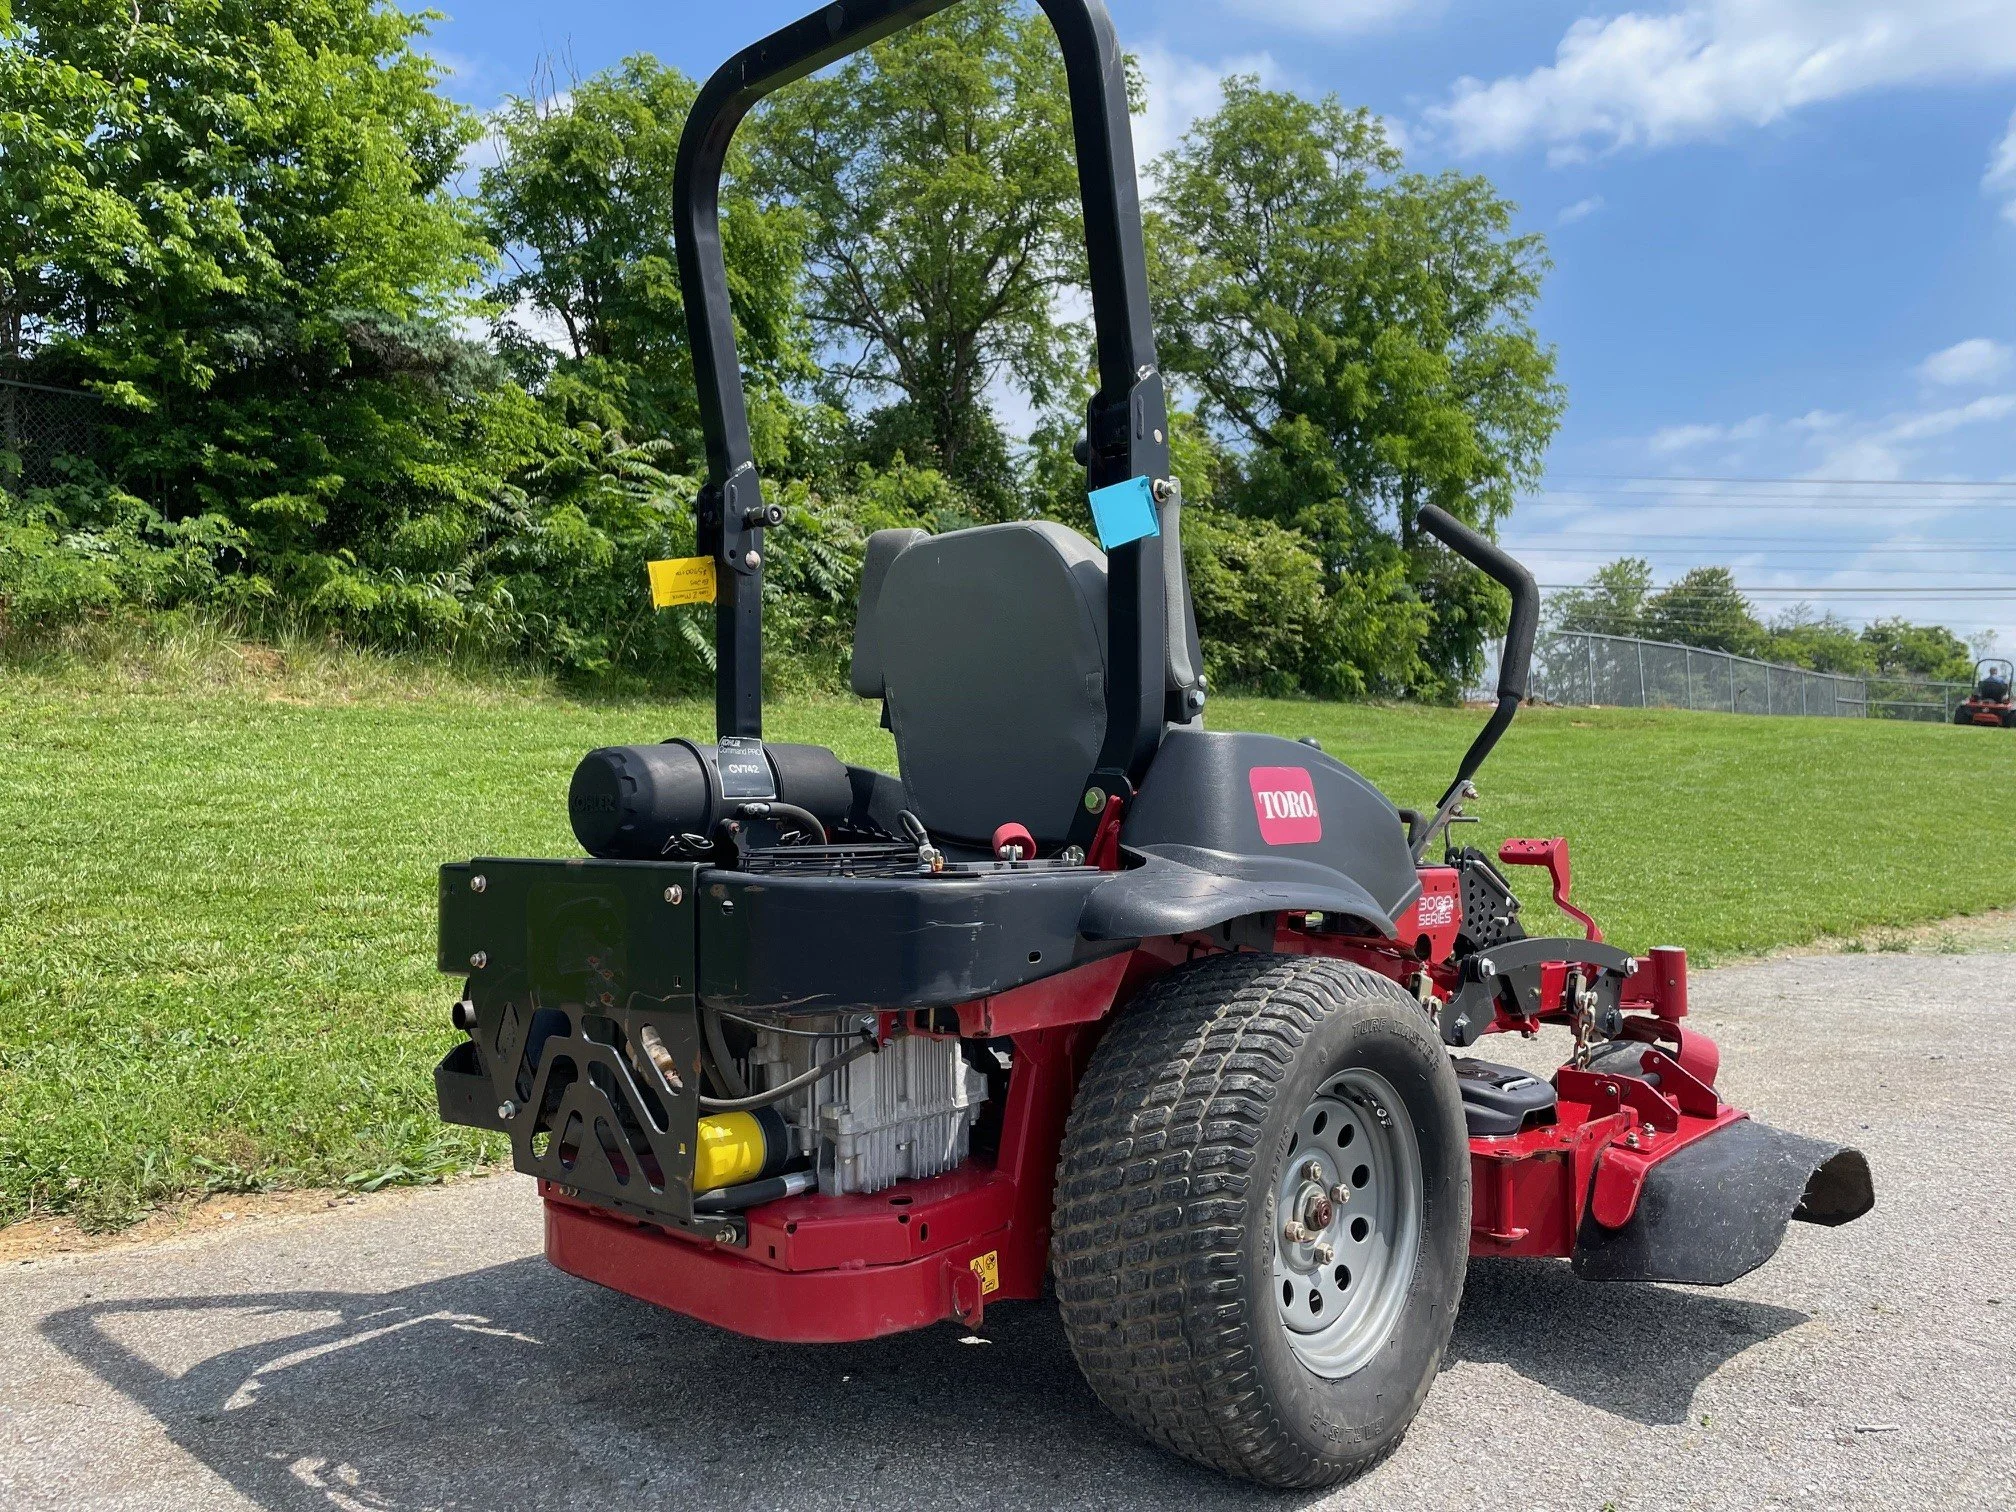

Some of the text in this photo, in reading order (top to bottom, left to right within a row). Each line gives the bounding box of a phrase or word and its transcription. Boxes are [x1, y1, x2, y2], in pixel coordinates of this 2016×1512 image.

[719, 746, 762, 756] Command PRO
[728, 764, 760, 774] CV742
[1257, 790, 1316, 819] TORO
[1418, 912, 1452, 926] SERIES
[1352, 1015, 1440, 1072] TURF MASTER
[1309, 1412, 1385, 1444] CARLISLE
